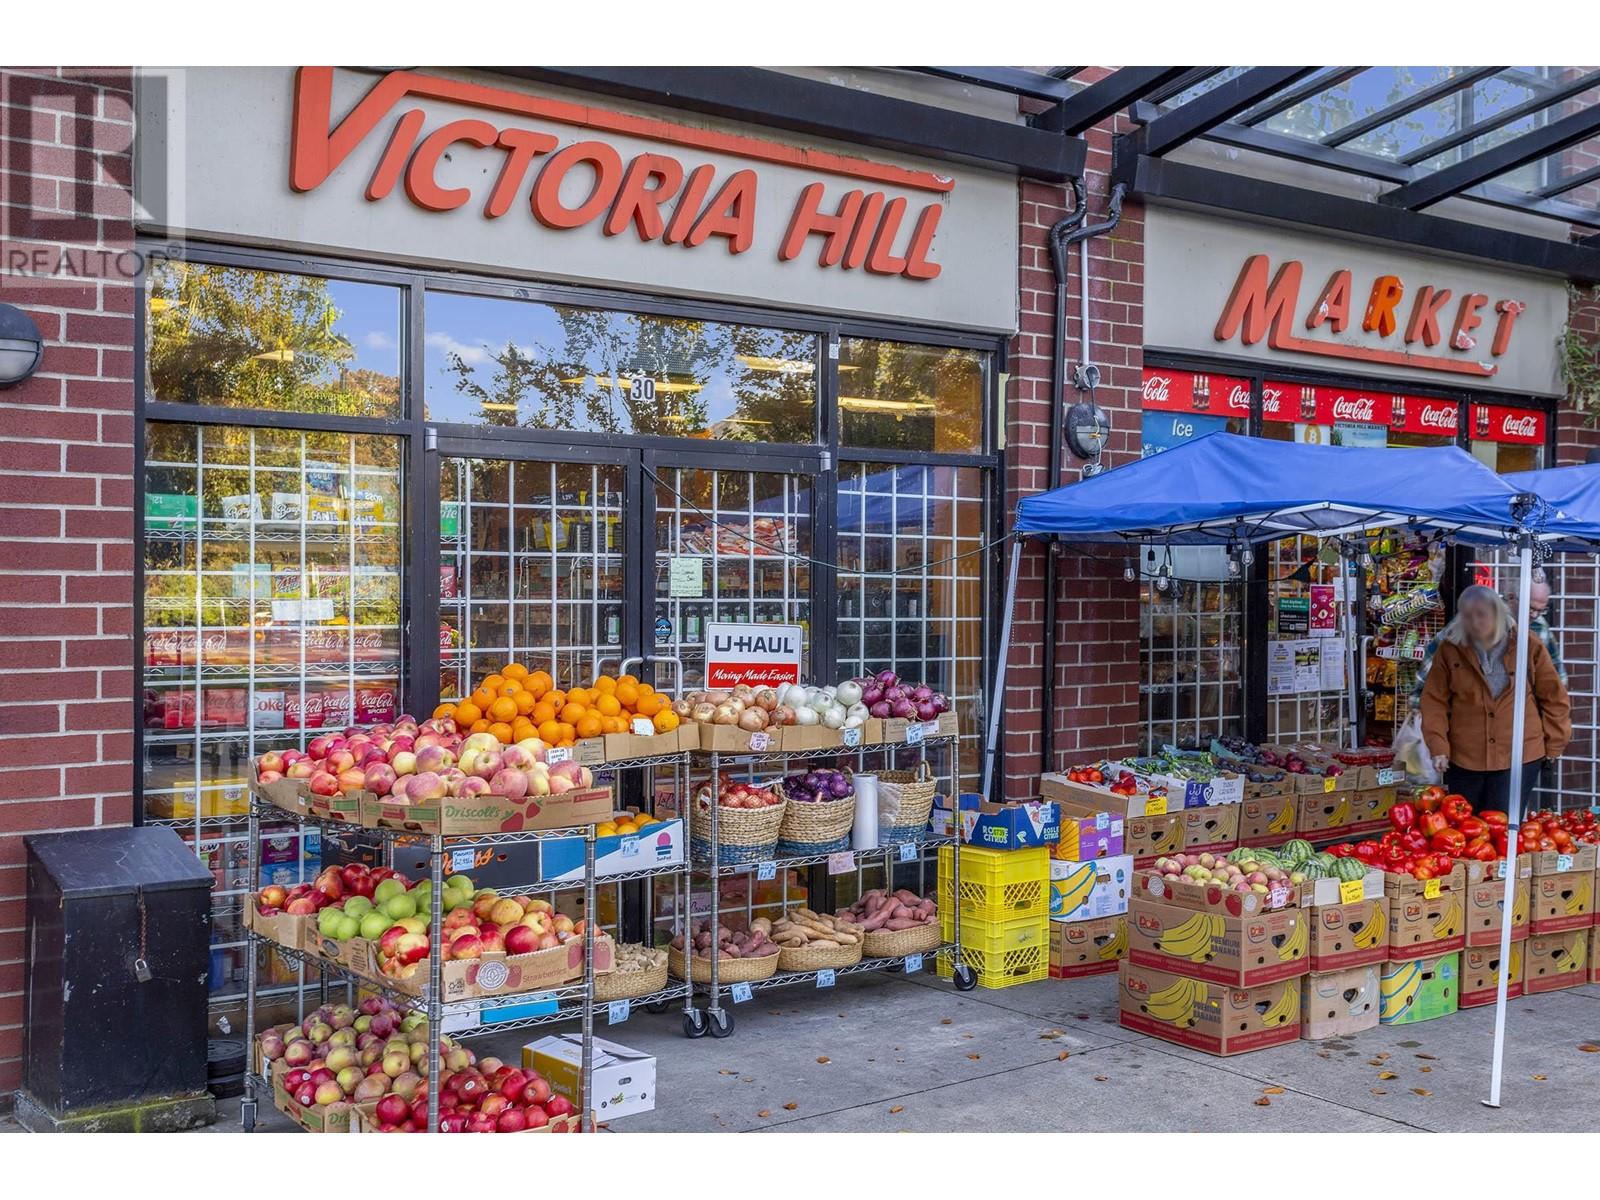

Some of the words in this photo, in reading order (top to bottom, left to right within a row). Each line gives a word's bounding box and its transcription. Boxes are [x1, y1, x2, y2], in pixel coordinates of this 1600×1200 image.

[289, 66, 759, 256] VICTORIA
[777, 181, 942, 281] HILL
[1213, 253, 1527, 357] MARKET
[632, 378, 655, 400] 30
[1172, 418, 1193, 437] Ice
[714, 635, 794, 654] U-HAUL
[711, 669, 742, 683] Moving
[742, 669, 767, 681] Made
[445, 805, 499, 818] Driscoll's
[982, 825, 1009, 836] ROE
[1139, 915, 1160, 931] Dole
[1128, 977, 1147, 993] Dole
